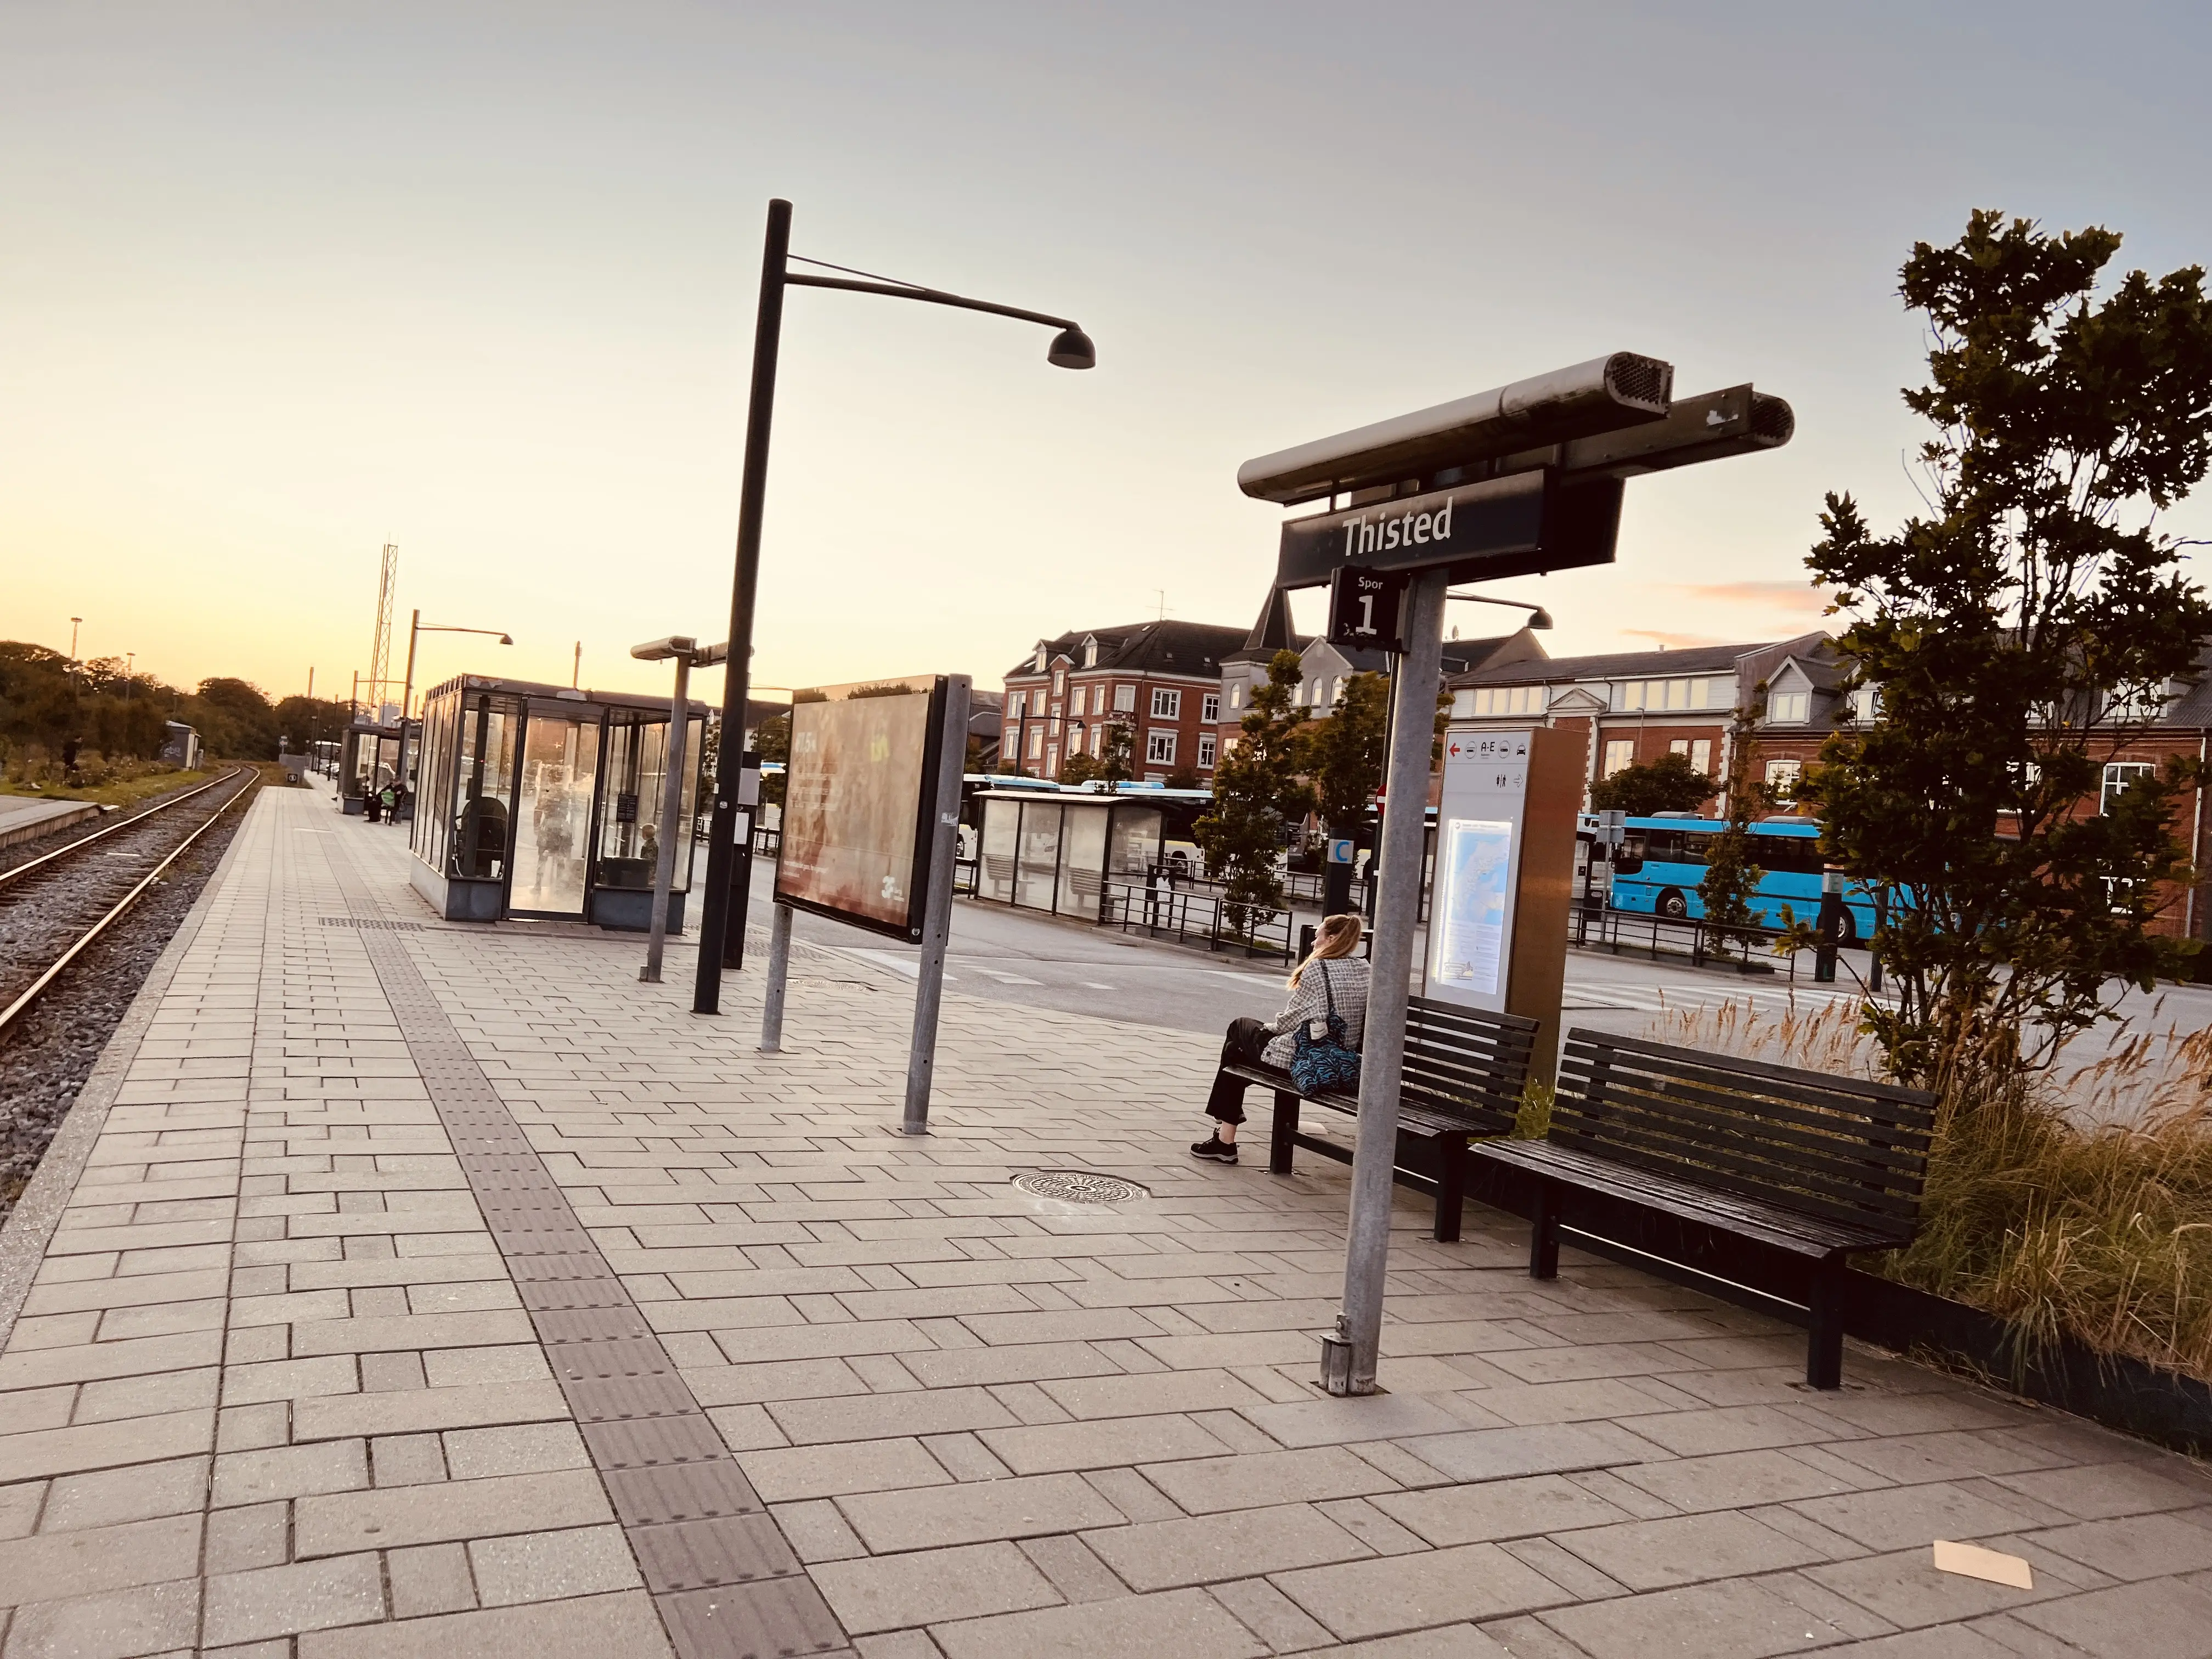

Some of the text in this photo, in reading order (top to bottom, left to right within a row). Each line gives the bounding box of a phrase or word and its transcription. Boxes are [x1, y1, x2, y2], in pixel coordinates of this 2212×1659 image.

[1342, 496, 1453, 556] Thisted
[1358, 577, 1383, 590] Spor
[1356, 595, 1377, 635] 1
[1481, 742, 1496, 752] A-E
[1336, 841, 1350, 862] C
